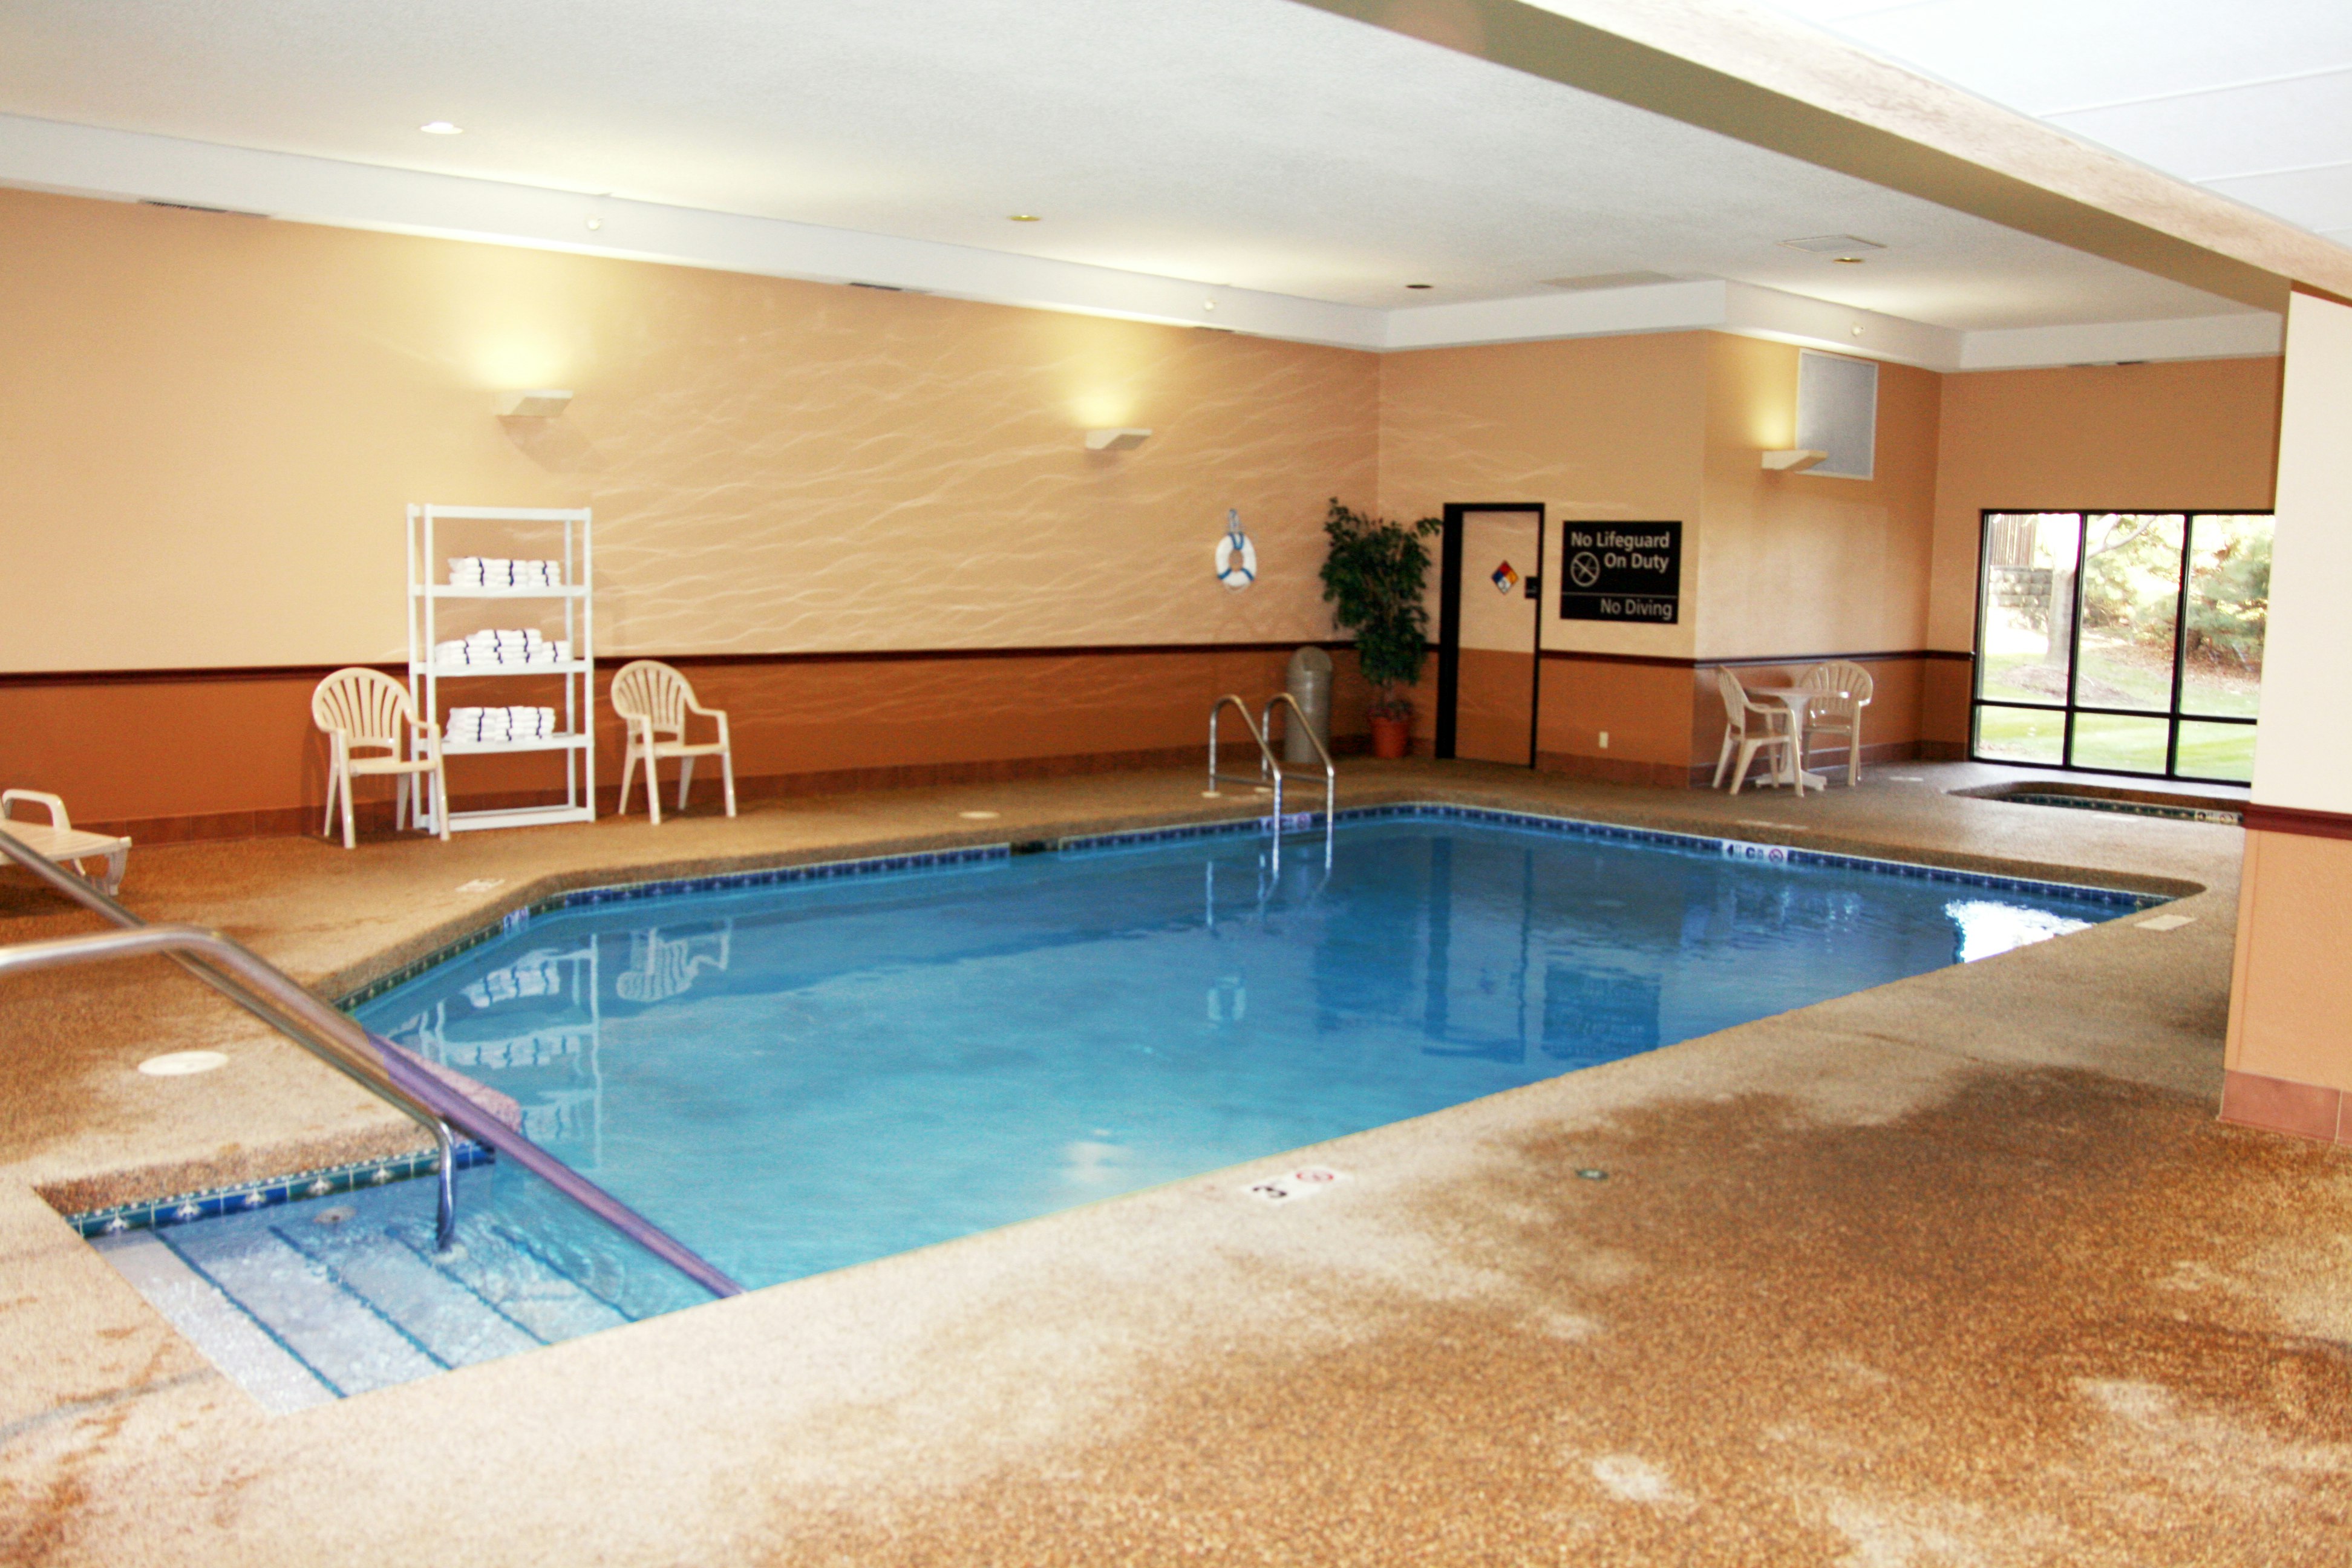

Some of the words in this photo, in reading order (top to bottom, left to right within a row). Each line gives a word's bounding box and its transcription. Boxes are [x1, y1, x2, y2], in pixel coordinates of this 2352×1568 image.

[1571, 532, 1592, 547] No
[1596, 531, 1670, 552] Lifeguard
[1604, 552, 1627, 569] On
[1631, 553, 1668, 573] Duty
[1601, 598, 1621, 614] No
[1625, 599, 1673, 621] Diving
